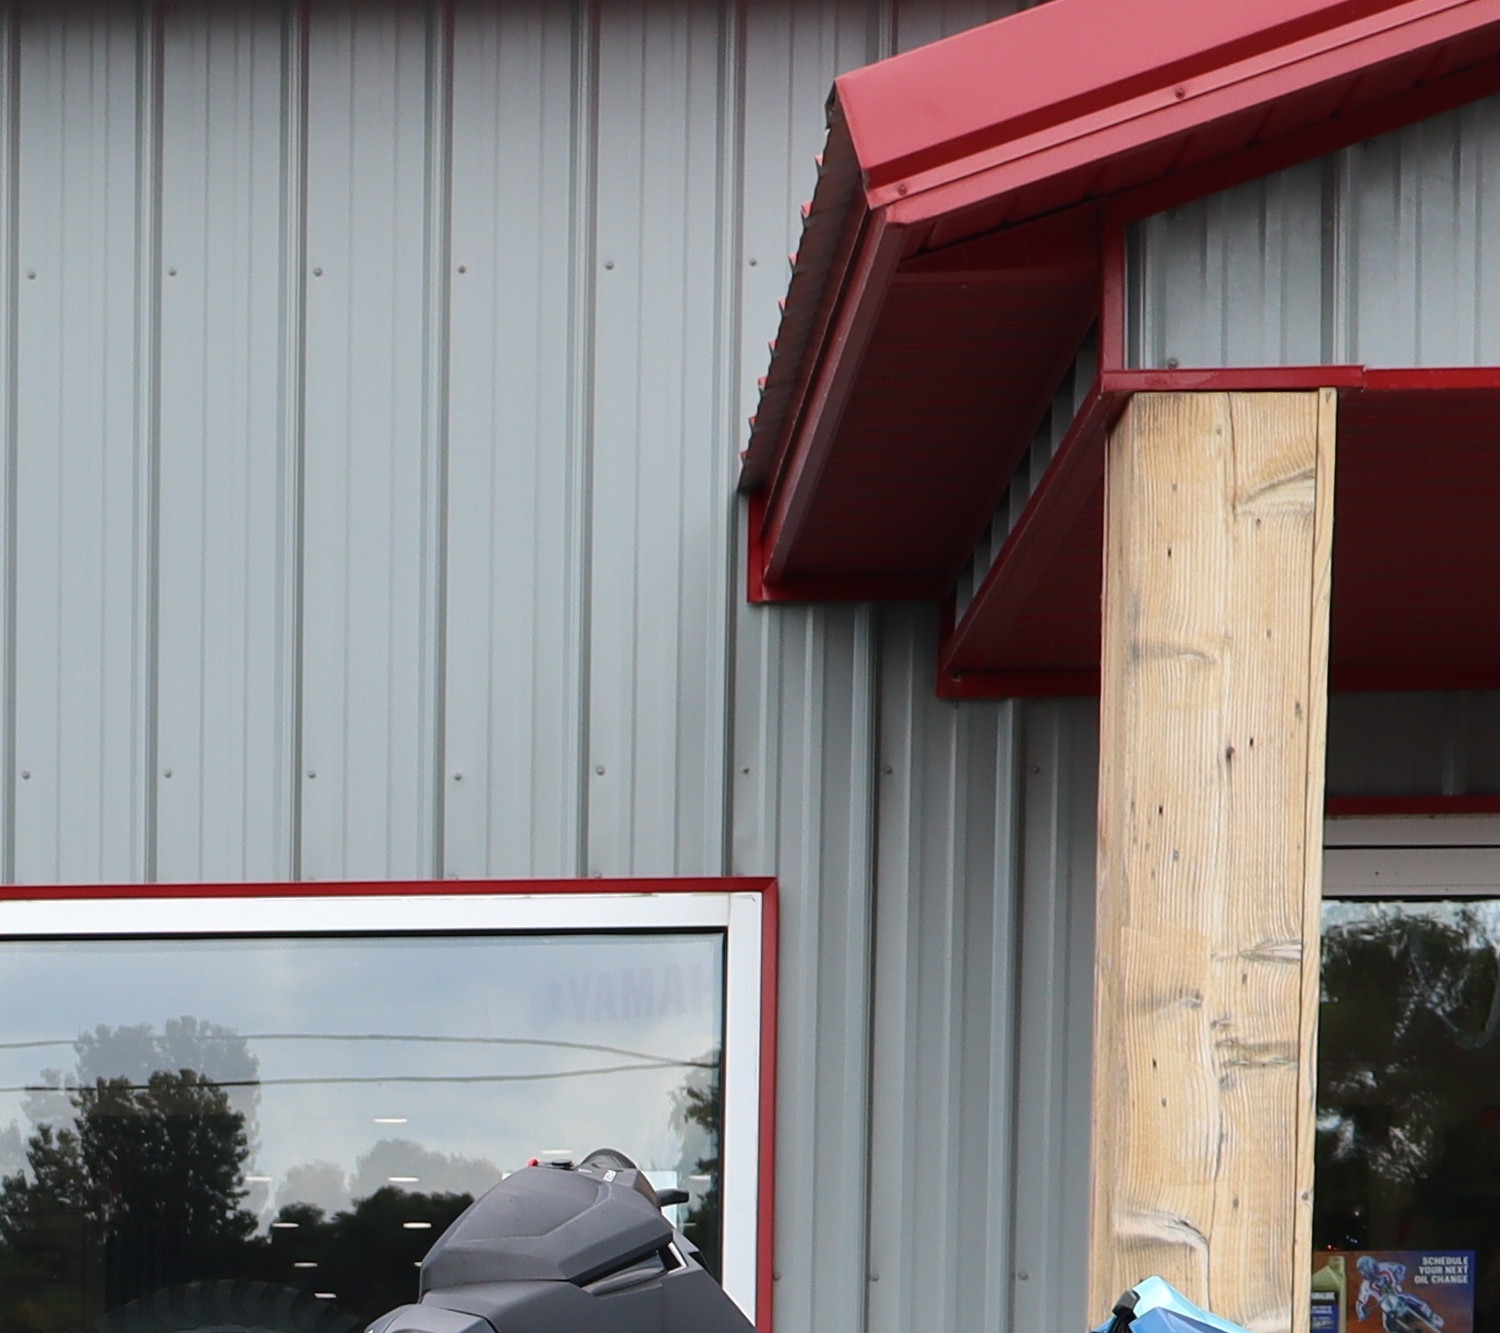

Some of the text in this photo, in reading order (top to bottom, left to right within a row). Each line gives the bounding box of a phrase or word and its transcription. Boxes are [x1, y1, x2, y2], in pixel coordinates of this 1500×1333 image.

[1422, 1256, 1469, 1266] SCHEDULE
[1418, 1265, 1469, 1275] YOUR NEXT
[1414, 1274, 1469, 1284] OIL CHANGE
